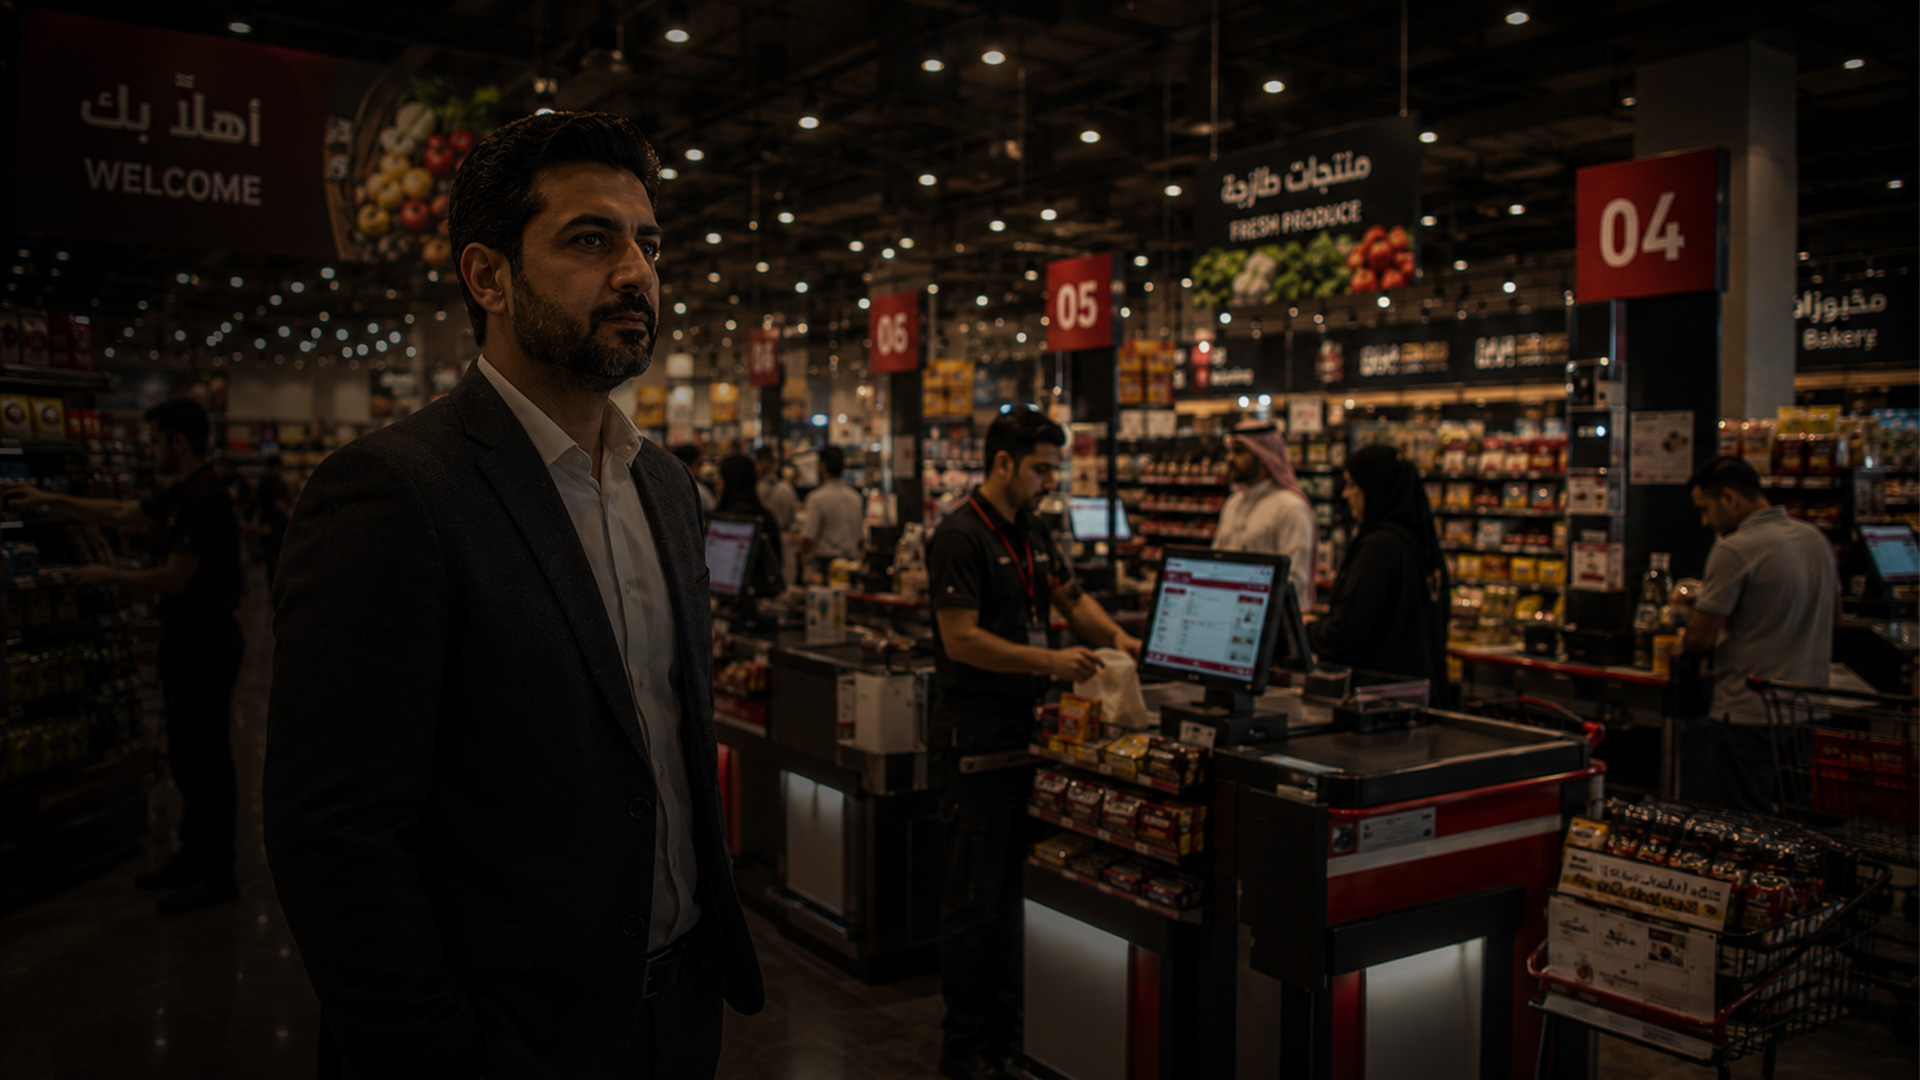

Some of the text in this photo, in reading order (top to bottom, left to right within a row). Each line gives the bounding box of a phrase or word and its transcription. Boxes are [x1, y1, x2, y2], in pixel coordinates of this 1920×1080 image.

[80, 83, 153, 146] بك
[83, 156, 263, 207] WELCOME
[1220, 150, 1372, 210] منتجات طازجة
[1229, 198, 1363, 242] FRESH PRODUCE
[1598, 190, 1686, 268] 04
[1055, 279, 1099, 331] 05
[876, 311, 910, 356] 06
[1802, 325, 1879, 352] Bakery
